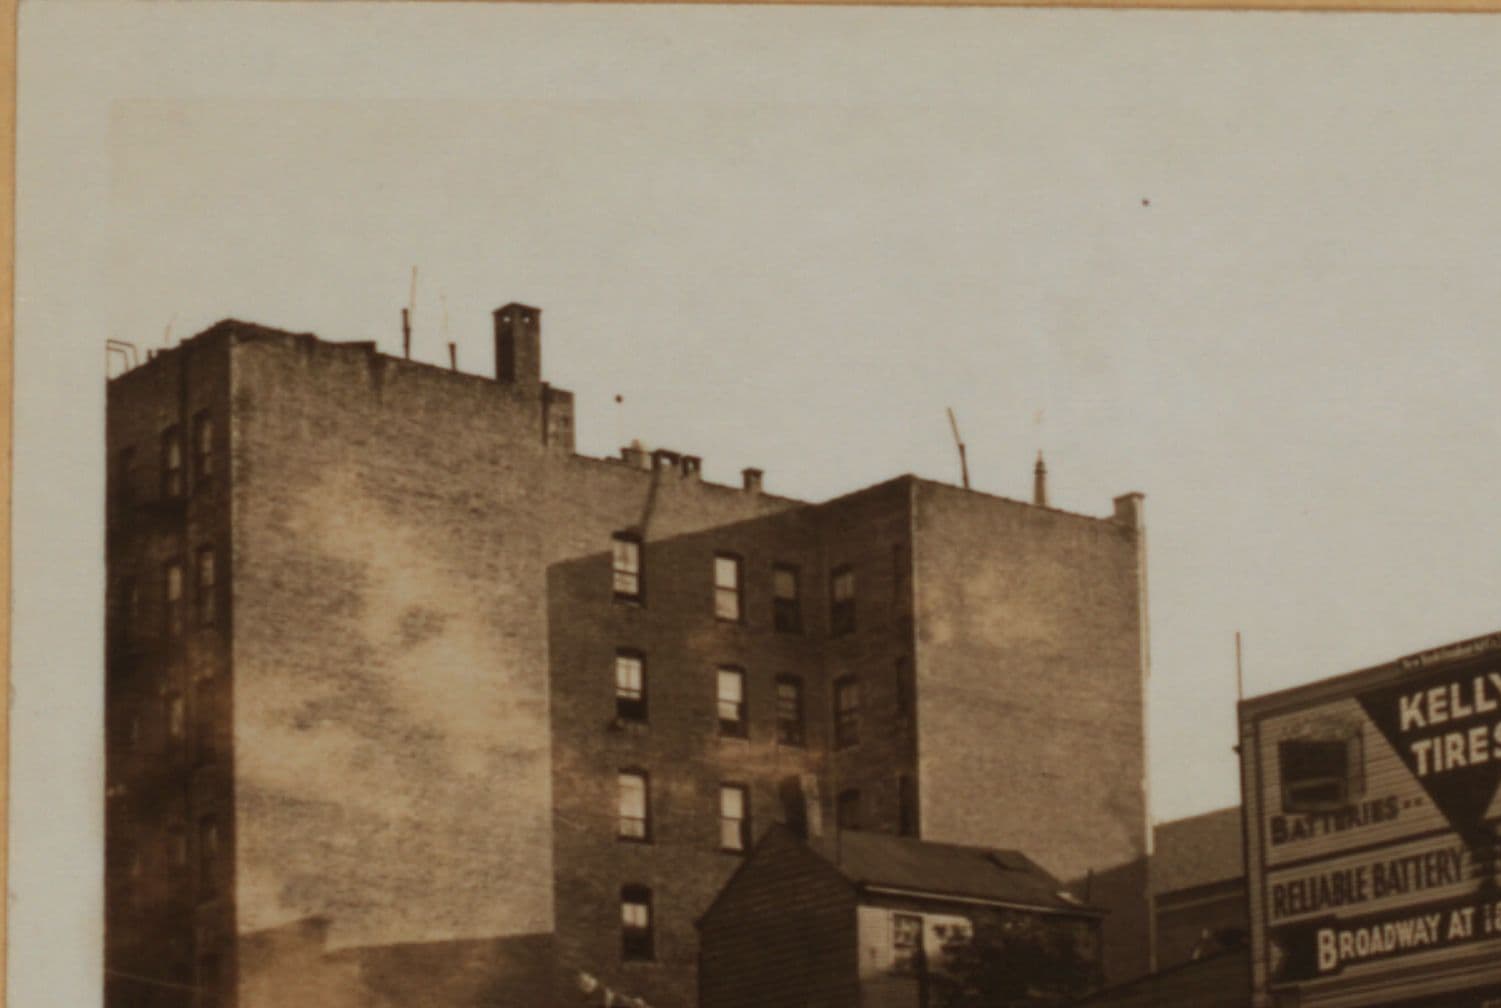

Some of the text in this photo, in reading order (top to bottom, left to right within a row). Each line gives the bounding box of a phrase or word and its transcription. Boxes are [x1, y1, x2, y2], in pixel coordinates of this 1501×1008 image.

[1273, 865, 1367, 918] RELIABLE
[1373, 847, 1462, 898] BATTERY
[1317, 912, 1441, 971] BROADWAY
[1448, 907, 1475, 939] AT
